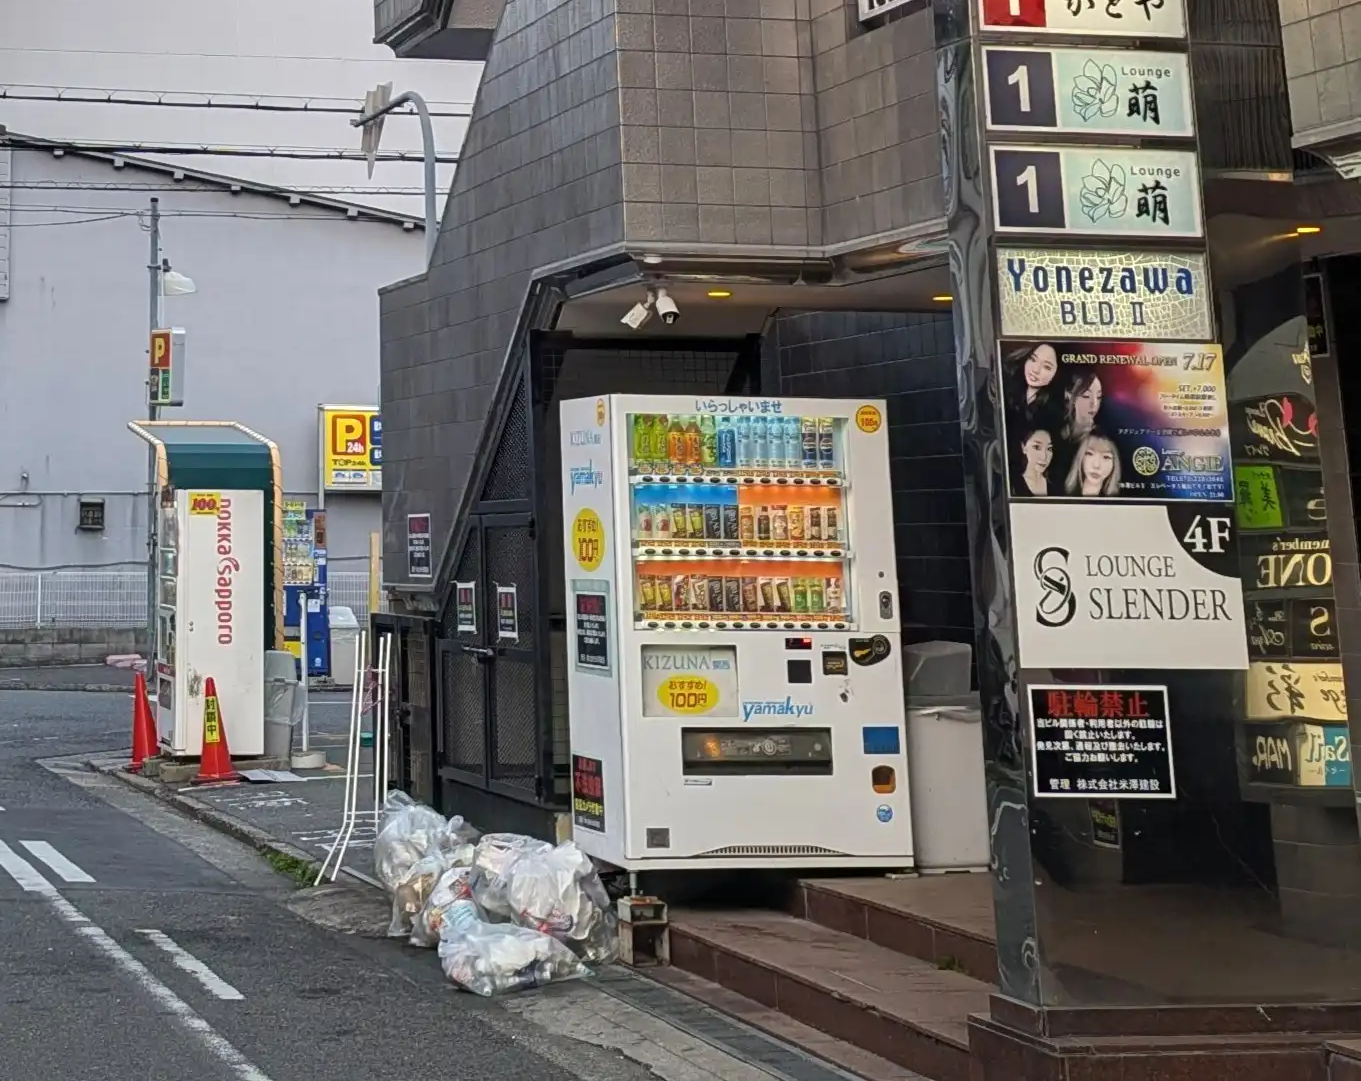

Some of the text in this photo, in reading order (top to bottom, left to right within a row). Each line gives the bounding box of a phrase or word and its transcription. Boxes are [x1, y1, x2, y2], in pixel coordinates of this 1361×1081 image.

[1121, 66, 1171, 78] Lounge
[1007, 65, 1031, 112] 1
[1126, 80, 1161, 125] 萌
[1130, 165, 1181, 178] Lounge
[1016, 165, 1039, 213] 1
[1136, 180, 1170, 226] 萌
[1007, 258, 1194, 295] Yonezawa
[154, 338, 165, 364] P
[1061, 353, 1098, 364] GRAND
[1099, 354, 1149, 366] RENEWAL
[1151, 355, 1178, 367] OPEN
[695, 399, 782, 414] いらっしゃいませ
[336, 418, 363, 452] P
[347, 442, 364, 453] 24h
[1183, 515, 1232, 554] 4F
[1085, 555, 1176, 578] LOUNGE
[1089, 588, 1233, 621] SLENDER
[644, 654, 710, 670] KIZUNA
[668, 680, 707, 690] おすすめ!
[742, 696, 813, 722] yamakyu
[1047, 691, 1151, 718] 駐輪禁止
[1049, 779, 1071, 791] 管理
